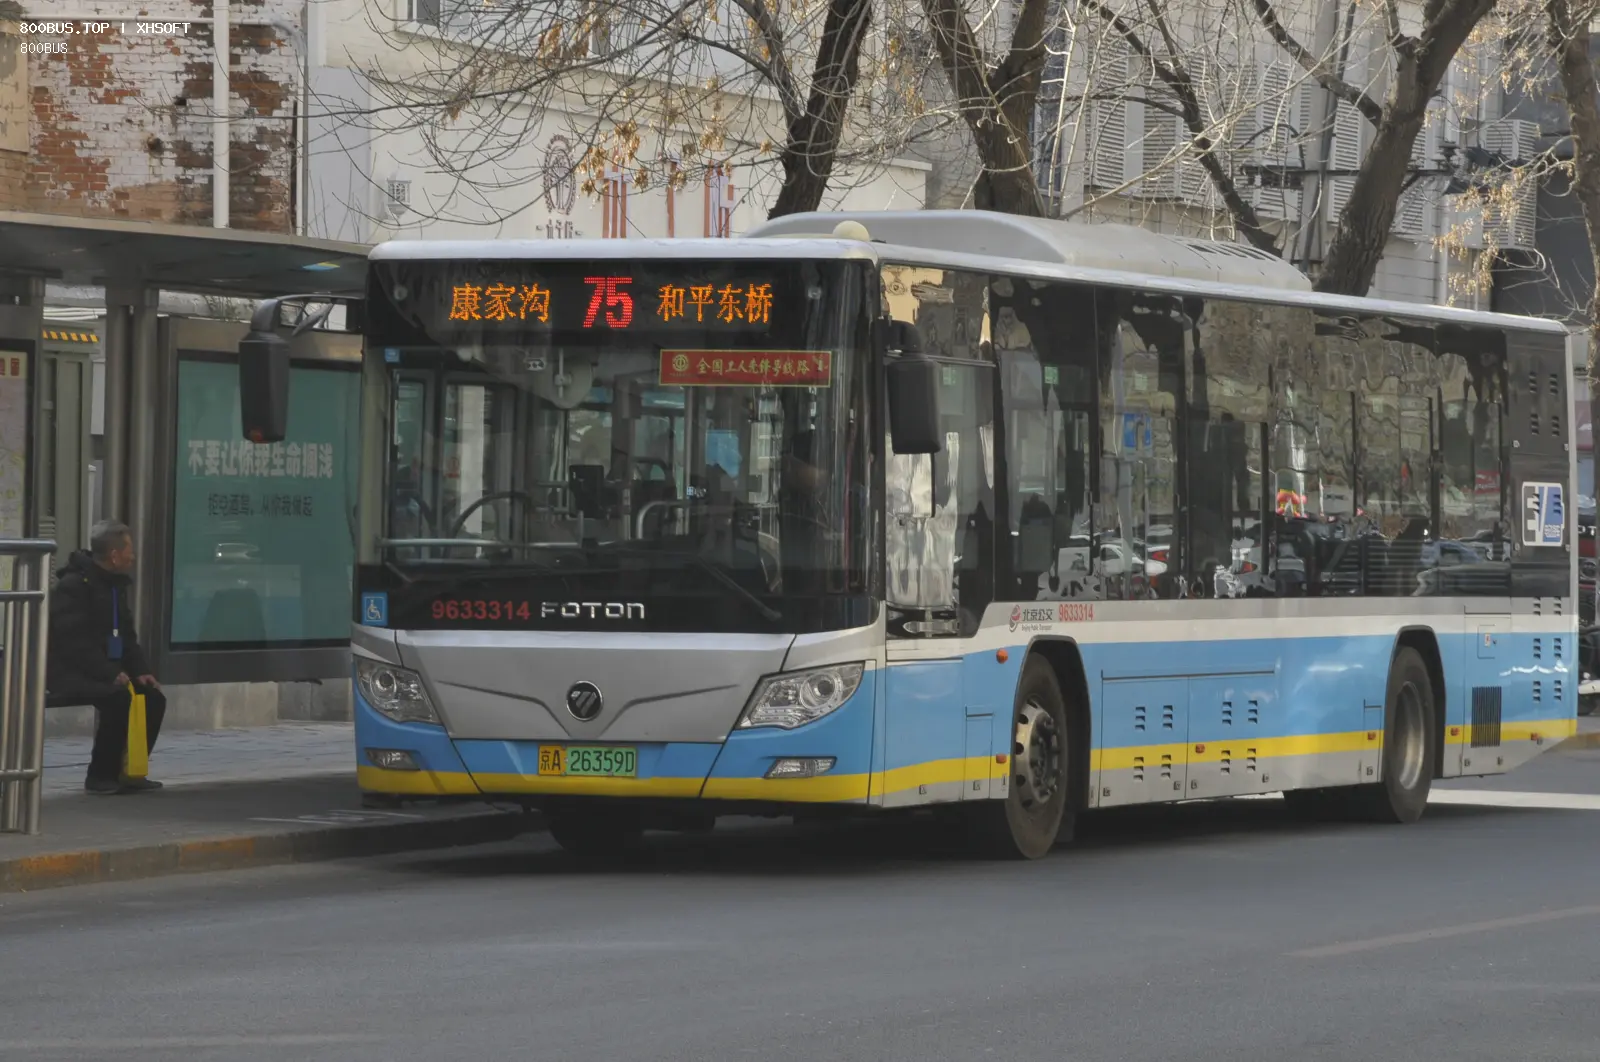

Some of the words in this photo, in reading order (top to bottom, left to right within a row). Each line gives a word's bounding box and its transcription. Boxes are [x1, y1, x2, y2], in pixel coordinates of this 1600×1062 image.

[449, 283, 550, 322] 康家沟
[582, 276, 632, 328] 75
[656, 283, 773, 322] 和平东桥
[696, 356, 810, 378] 全国工人先锋号线路
[432, 600, 531, 620] 9633314
[541, 602, 645, 619] FOTON
[1022, 608, 1053, 621] 北京公交
[1058, 604, 1093, 622] 9633314
